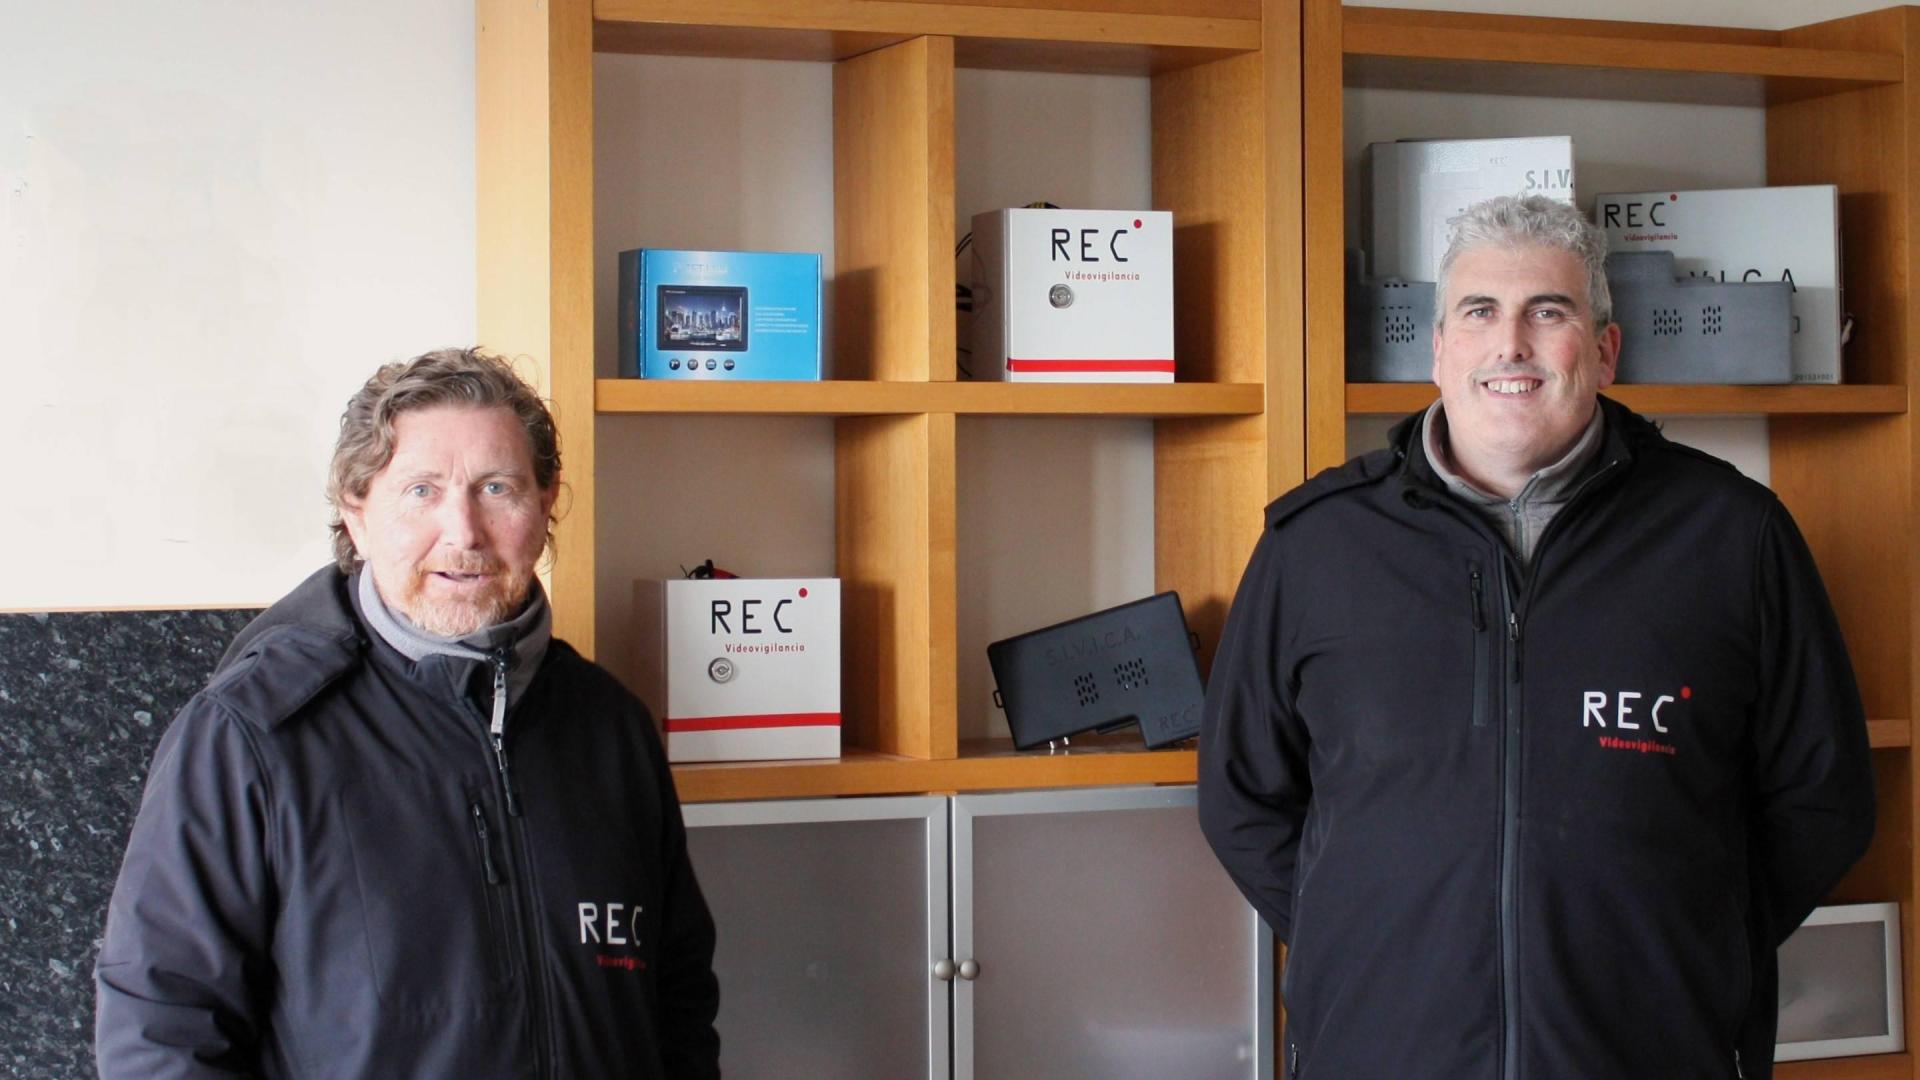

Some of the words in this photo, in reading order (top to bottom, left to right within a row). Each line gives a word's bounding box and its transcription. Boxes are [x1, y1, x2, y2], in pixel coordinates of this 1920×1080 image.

[1604, 201, 1666, 228] REC
[1051, 228, 1129, 262] REC
[1065, 271, 1141, 282] Videovigilancia
[711, 599, 793, 635] REC
[725, 643, 806, 655] Videovigilancia
[1582, 691, 1676, 733] REC
[577, 902, 644, 947] REC
